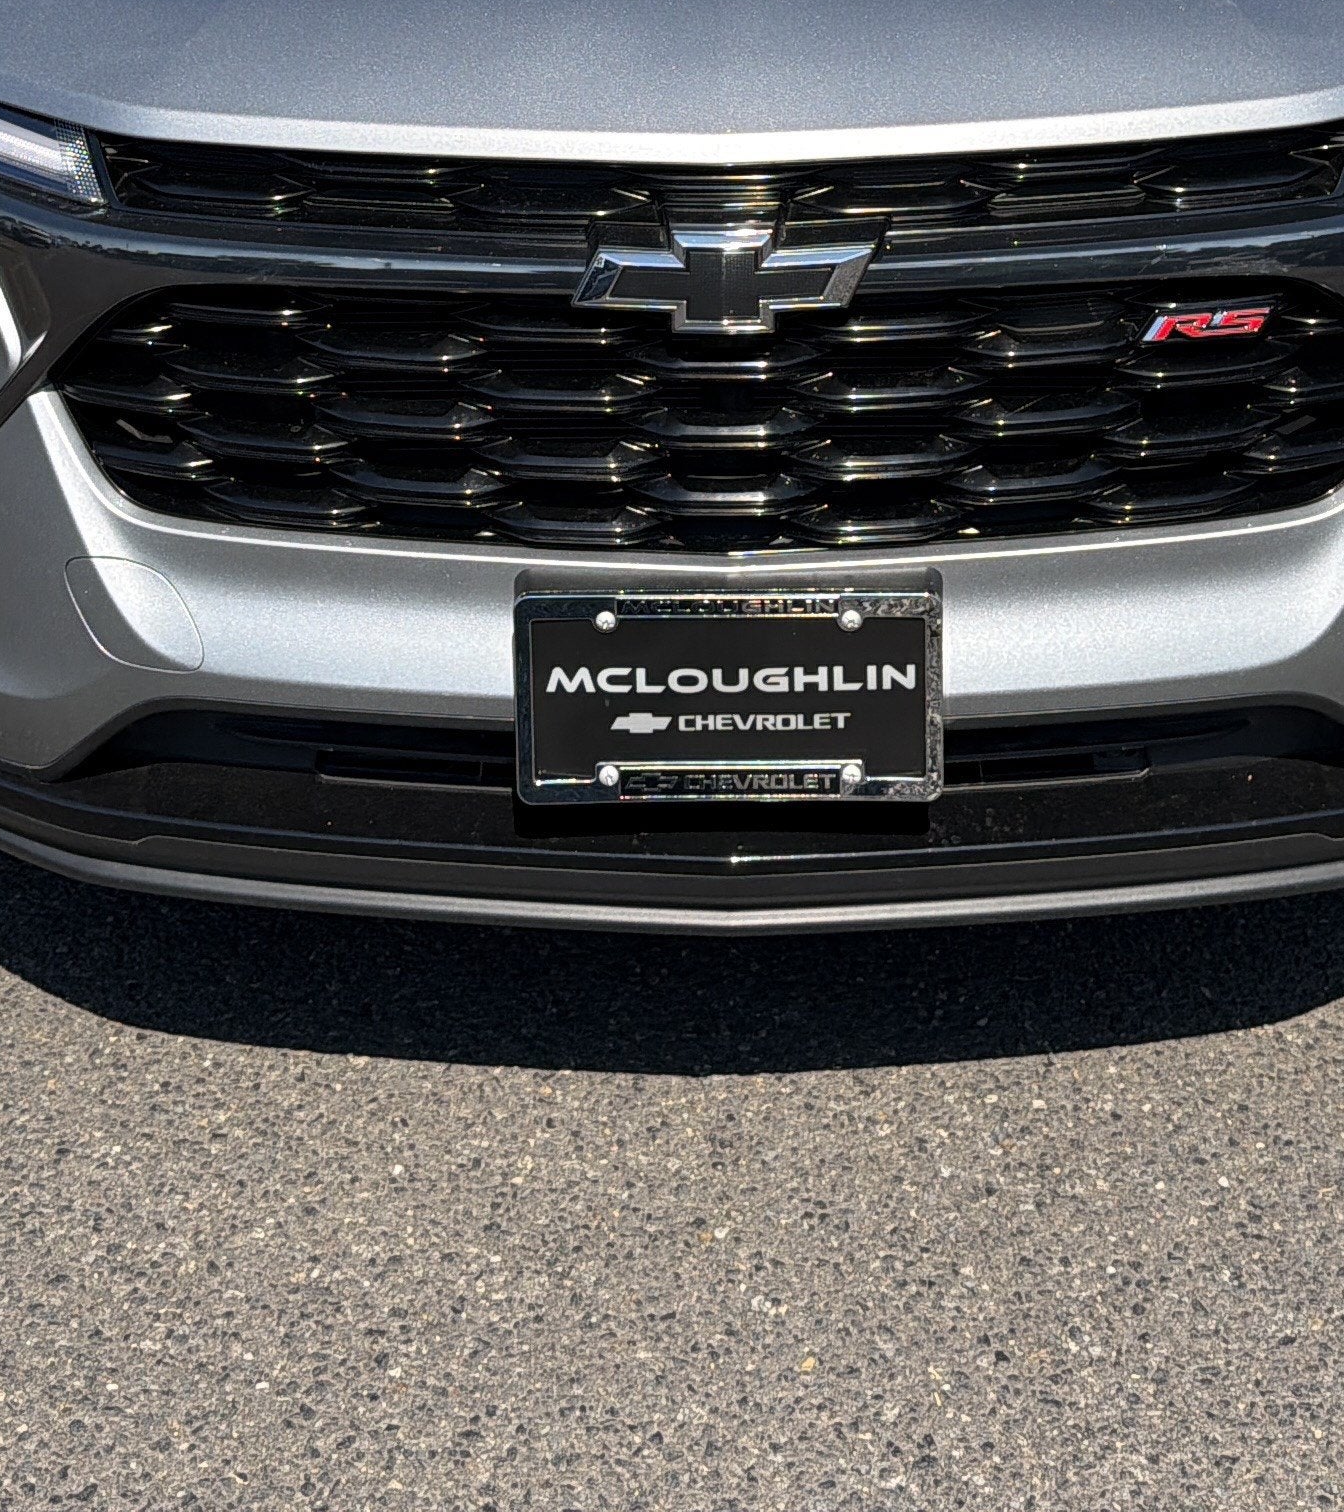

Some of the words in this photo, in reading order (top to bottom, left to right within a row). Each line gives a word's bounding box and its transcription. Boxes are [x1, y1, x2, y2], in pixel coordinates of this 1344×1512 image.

[1141, 306, 1271, 342] RS
[620, 598, 839, 615] MCLOUGHLIN
[545, 664, 917, 694] MCLOUGHLIN
[678, 712, 851, 732] CHEVROLET
[683, 772, 837, 791] CHEVROLET
